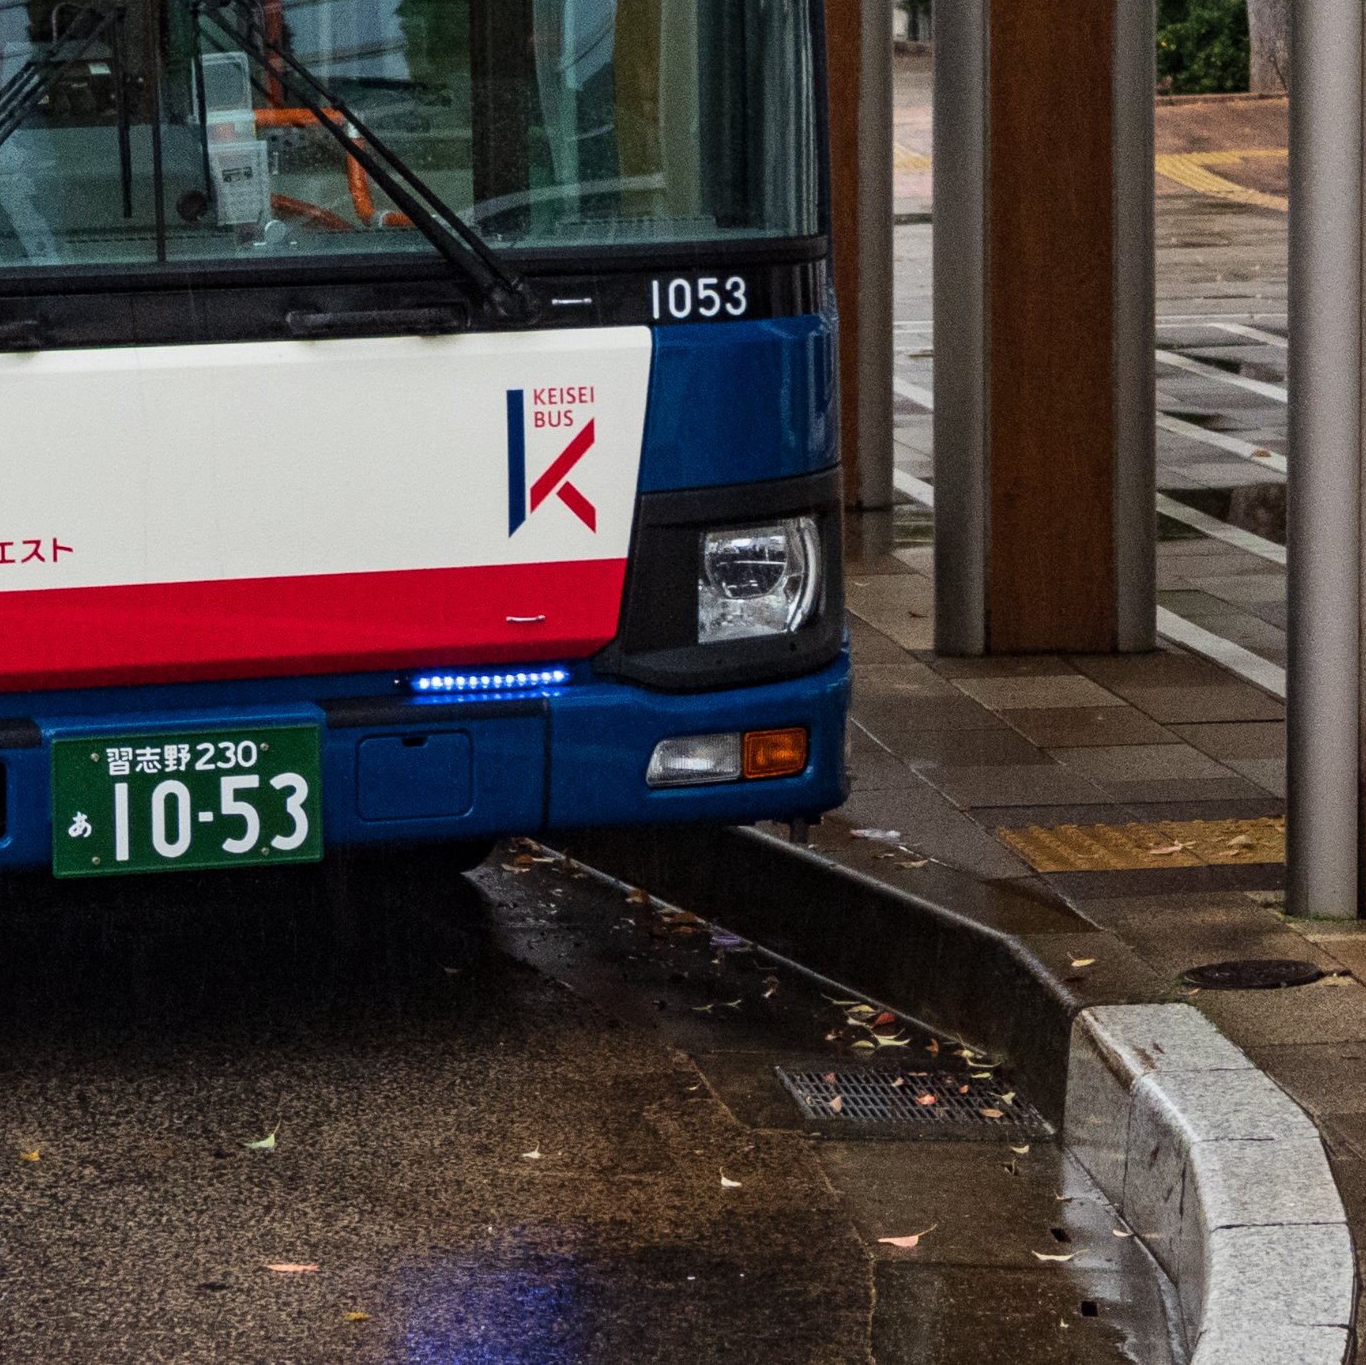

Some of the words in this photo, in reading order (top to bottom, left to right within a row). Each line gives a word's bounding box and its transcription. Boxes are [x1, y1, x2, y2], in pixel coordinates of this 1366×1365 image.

[652, 276, 747, 319] 1053
[532, 386, 595, 406] KEISEI
[533, 410, 574, 428] BUS
[68, 811, 92, 838] あ
[114, 772, 309, 862] 10-53
